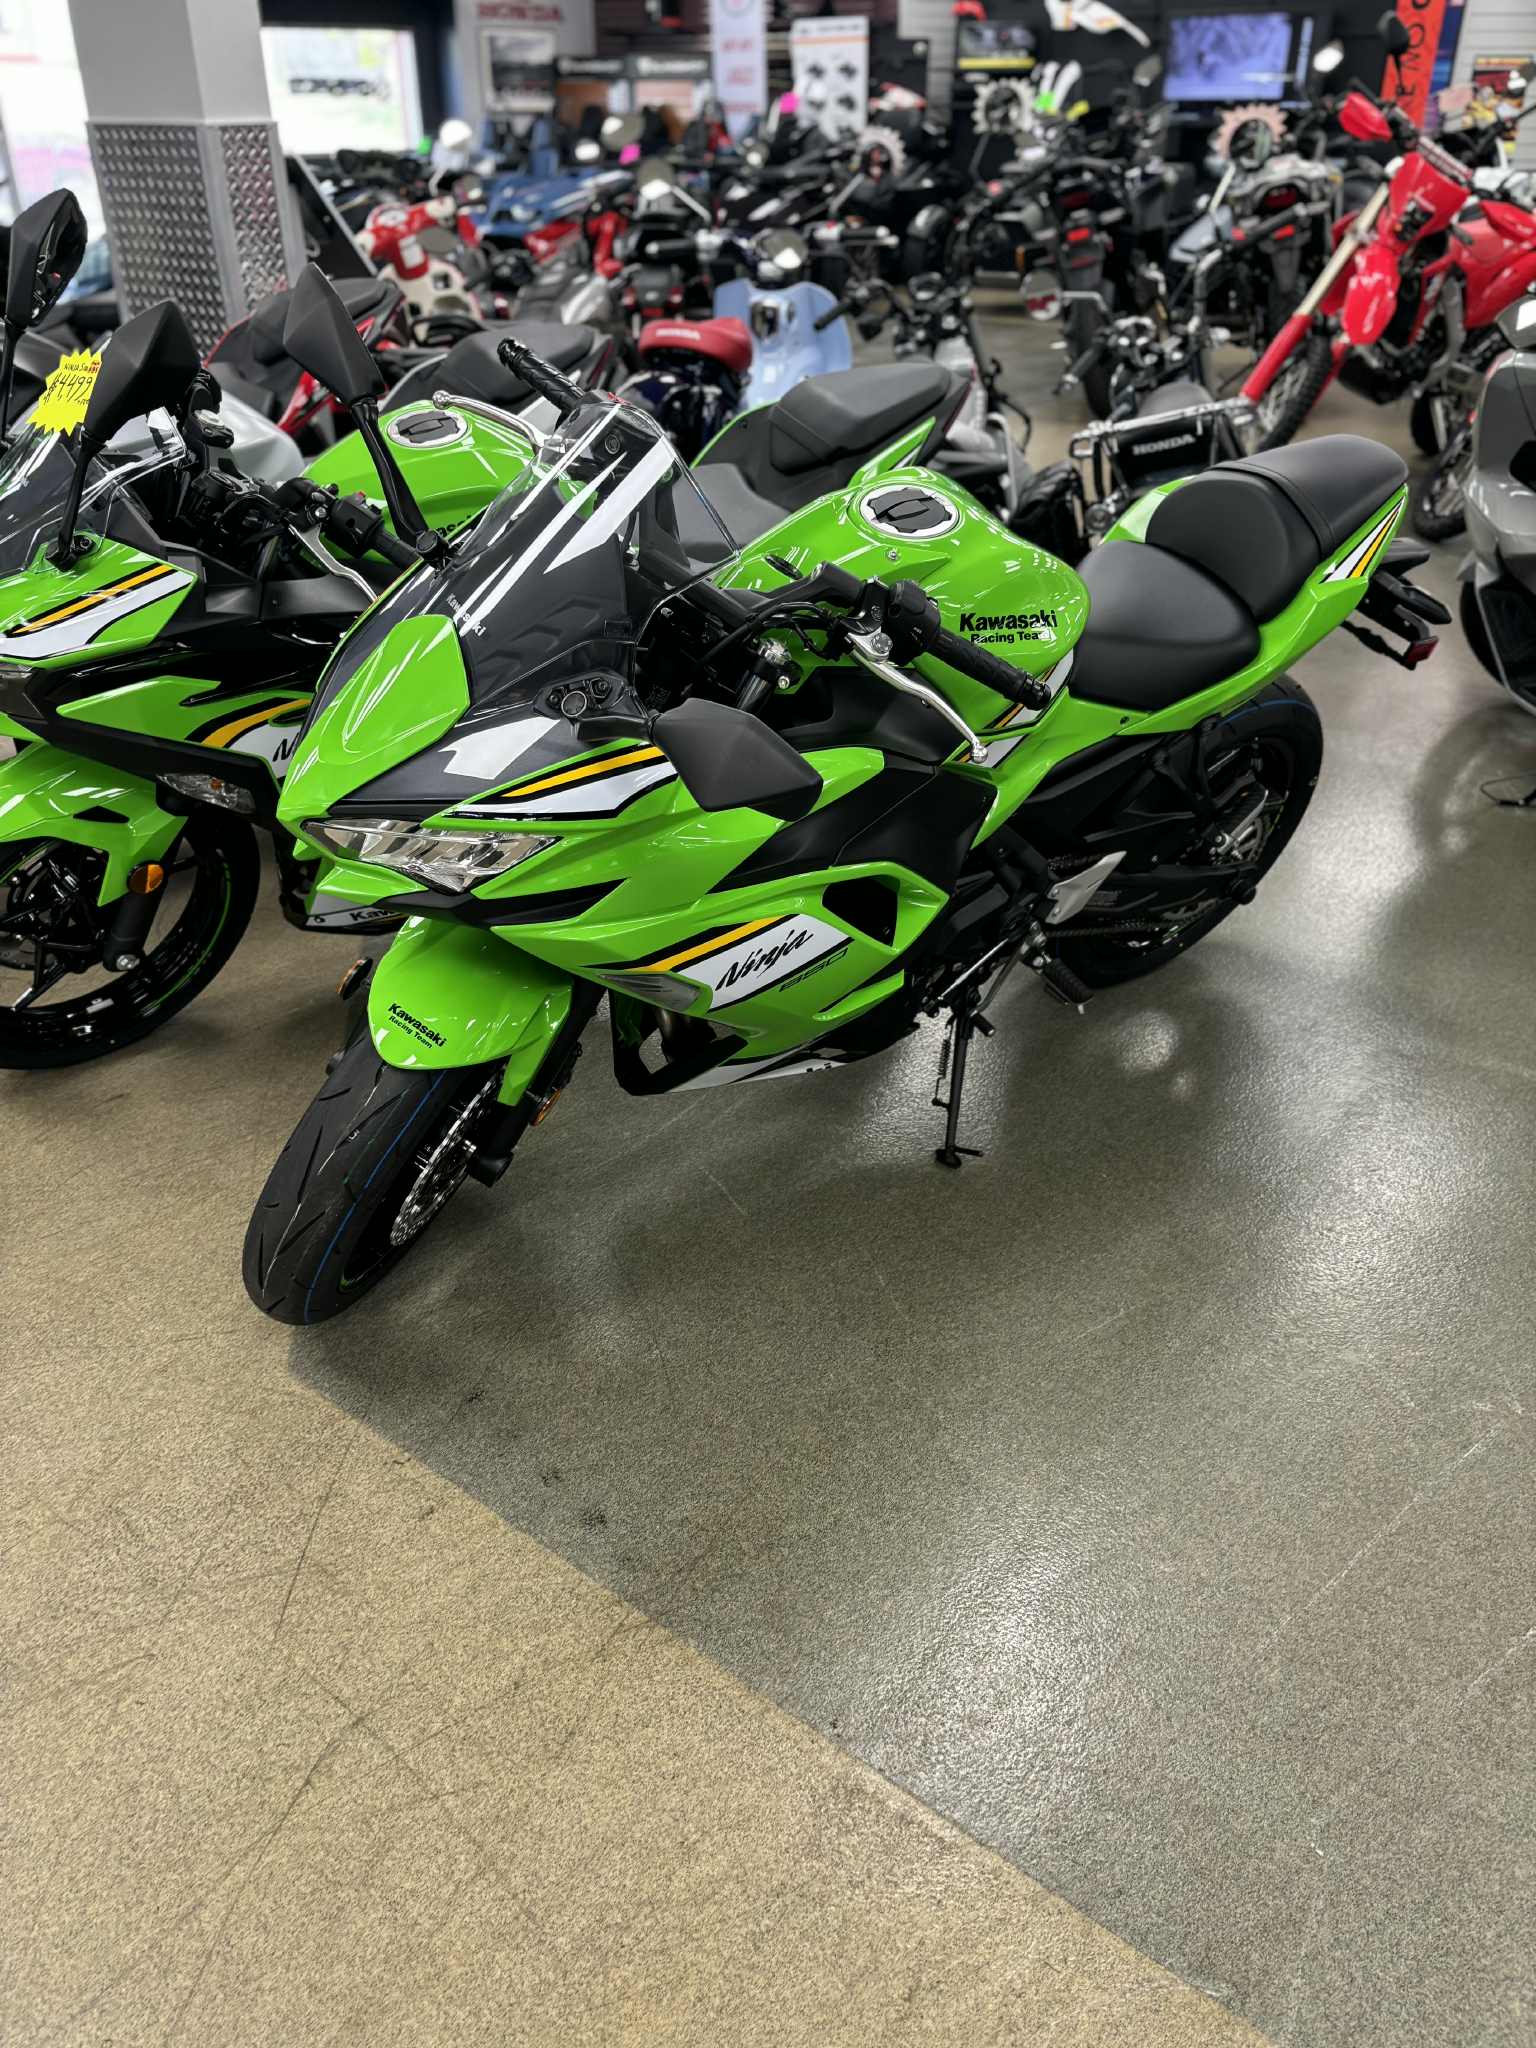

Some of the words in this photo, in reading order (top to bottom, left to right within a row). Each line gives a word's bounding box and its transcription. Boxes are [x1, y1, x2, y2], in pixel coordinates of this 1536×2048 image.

[1132, 434, 1195, 456] HONDA
[960, 610, 1058, 632] Kawasaki
[715, 929, 814, 991] Ninja
[388, 1003, 447, 1047] Kawasaki
[389, 1015, 413, 1034] Racing
[414, 1031, 433, 1048] Team
